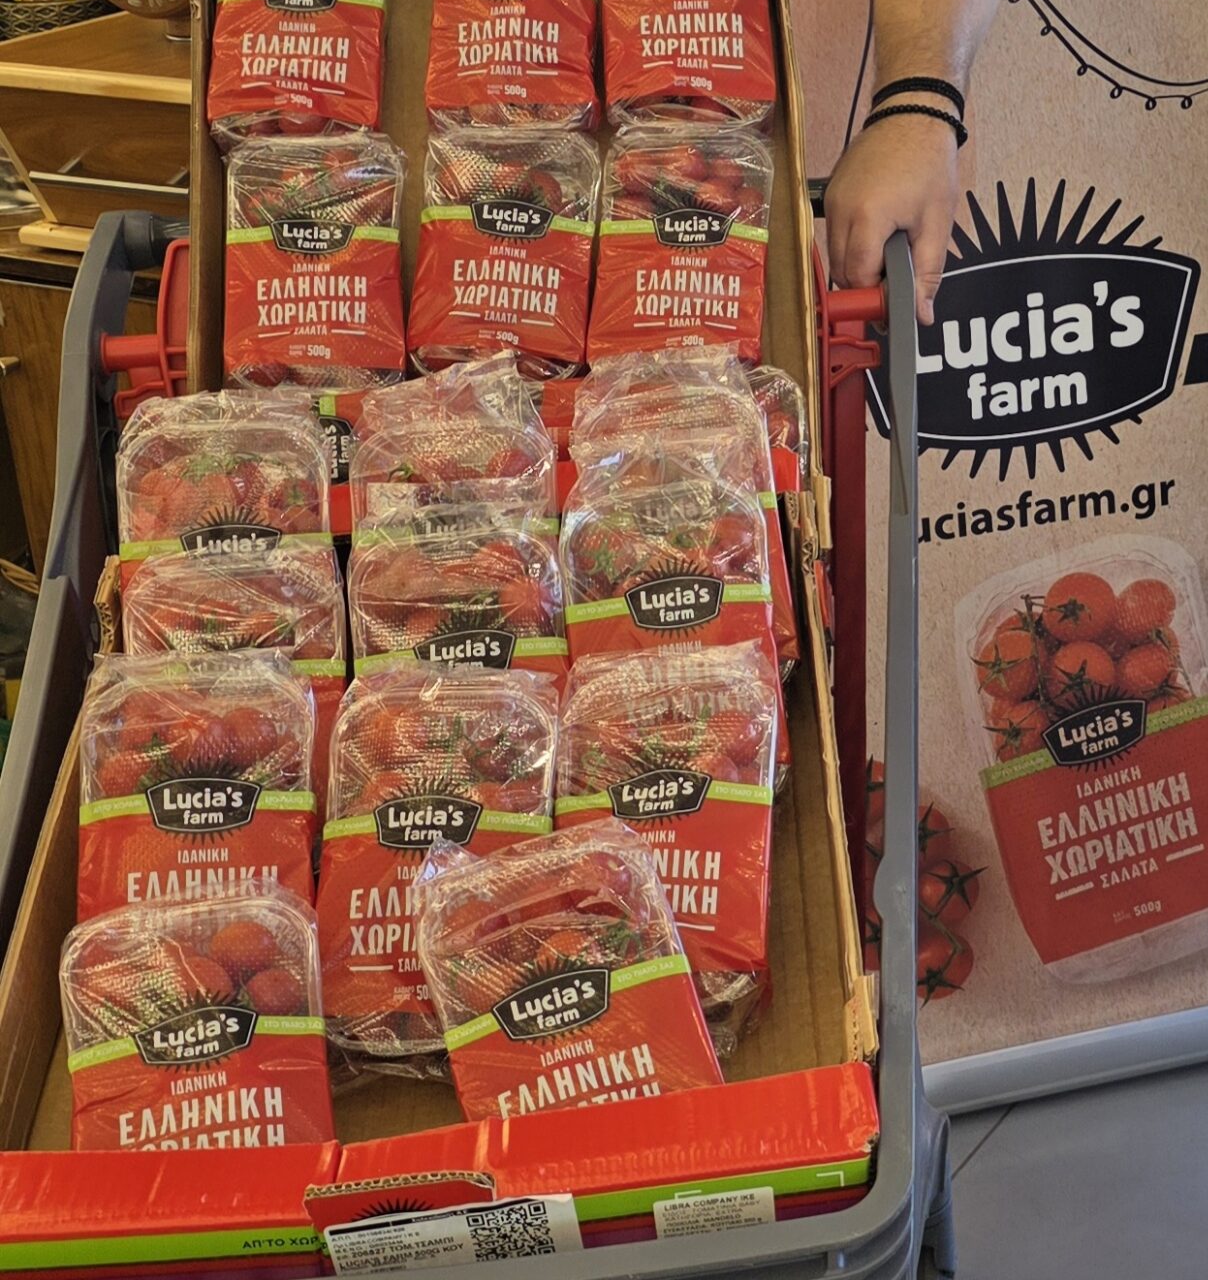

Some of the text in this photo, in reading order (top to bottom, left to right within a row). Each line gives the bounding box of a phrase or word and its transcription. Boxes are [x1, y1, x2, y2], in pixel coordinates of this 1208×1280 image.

[458, 18, 559, 44] ΕΛΛΗΝΙΚΗ
[640, 15, 743, 35] ΕΛΛΗΝΙΚΗ
[242, 33, 349, 59] ΕΛΛΗΝΙΚΗ
[458, 42, 558, 67] ΧΩΡΙΑΤΙΚΗ
[641, 37, 744, 58] ΧΩΡΙΑΤΙΚΗ
[241, 57, 347, 84] ΧΩΡΙΑΤΙΚΗ
[483, 205, 541, 224] Lucia's
[664, 215, 720, 232] Lucia's
[283, 224, 343, 239] Lucia's
[496, 221, 525, 234] farm
[677, 230, 706, 243] farm
[297, 238, 328, 250] farm
[454, 259, 560, 290] ΕΛΛΗΝΙΚΗ
[636, 270, 741, 297] ΕΛΛΗΝΙΚΗ
[257, 276, 367, 301] ΕΛΛΗΝΙΚΗ
[453, 284, 557, 316] ΧΩΡΙΑΤΙΚΗ
[258, 301, 367, 327] ΧΩΡΙΑΤΙΚΗ
[634, 294, 739, 319] ΧΩΡΙΑΤΙΚΗ
[967, 372, 1088, 420] farm
[196, 533, 268, 554] Lucia's
[640, 584, 711, 610] Lucia's
[659, 607, 695, 622] farm
[429, 637, 501, 662] Lucia's
[1058, 709, 1133, 748] Lucia's
[1081, 736, 1119, 756] farm
[622, 777, 694, 802] Lucia's
[1076, 766, 1142, 798] ΙΔΑΝΙΚΗ
[163, 787, 243, 810] Lucia's
[638, 800, 674, 813] farm
[1037, 772, 1191, 850] ΕΛΛΗΝΙΚΗ
[183, 809, 224, 824] farm
[388, 805, 464, 829] Lucia's
[404, 828, 442, 841] farm
[641, 830, 676, 843] ΑΝΙΚΗ
[1045, 807, 1198, 884] ΧΩΡΙΑΤΙΚΗ
[177, 848, 228, 864] ΙΔΑΝΙΚΗ
[652, 848, 721, 880] ΝΙΚΗ
[1101, 858, 1159, 888] ΣΑΛΑΤΑ
[1133, 900, 1161, 917] 500g
[510, 979, 596, 1022] Lucia's
[153, 1014, 240, 1048] Lucia's
[537, 1007, 581, 1030] farm
[176, 1041, 219, 1058] farm
[540, 1038, 595, 1067] ΙΔΑΝΙΚΗ
[171, 1071, 227, 1096] ΙΔΑΝΙΚΗ
[119, 1087, 283, 1146] ΕΛΛΗΝΙΚΗ
[664, 1202, 690, 1211] LIBRA
[693, 1195, 738, 1207] COMPANY
